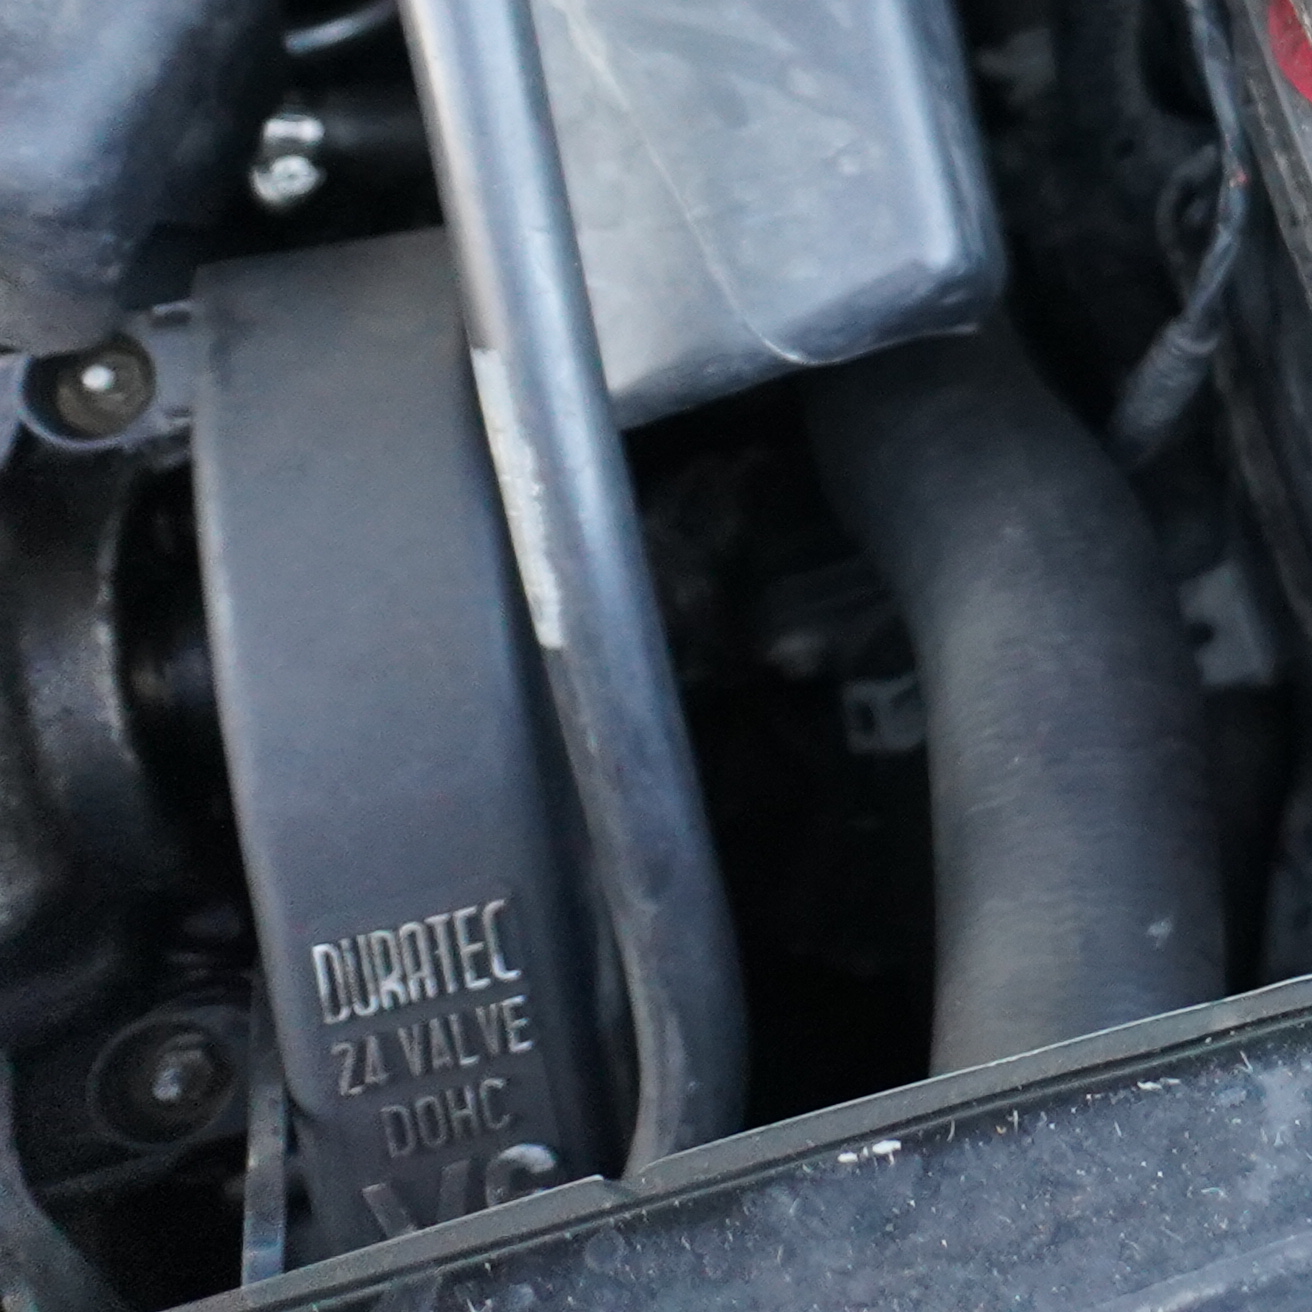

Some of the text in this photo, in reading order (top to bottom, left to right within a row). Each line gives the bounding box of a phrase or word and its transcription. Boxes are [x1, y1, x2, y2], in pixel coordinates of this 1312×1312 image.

[311, 898, 523, 1026] DURATEC
[330, 993, 534, 1097] 24 VALVE
[379, 1077, 514, 1159] DOHC
